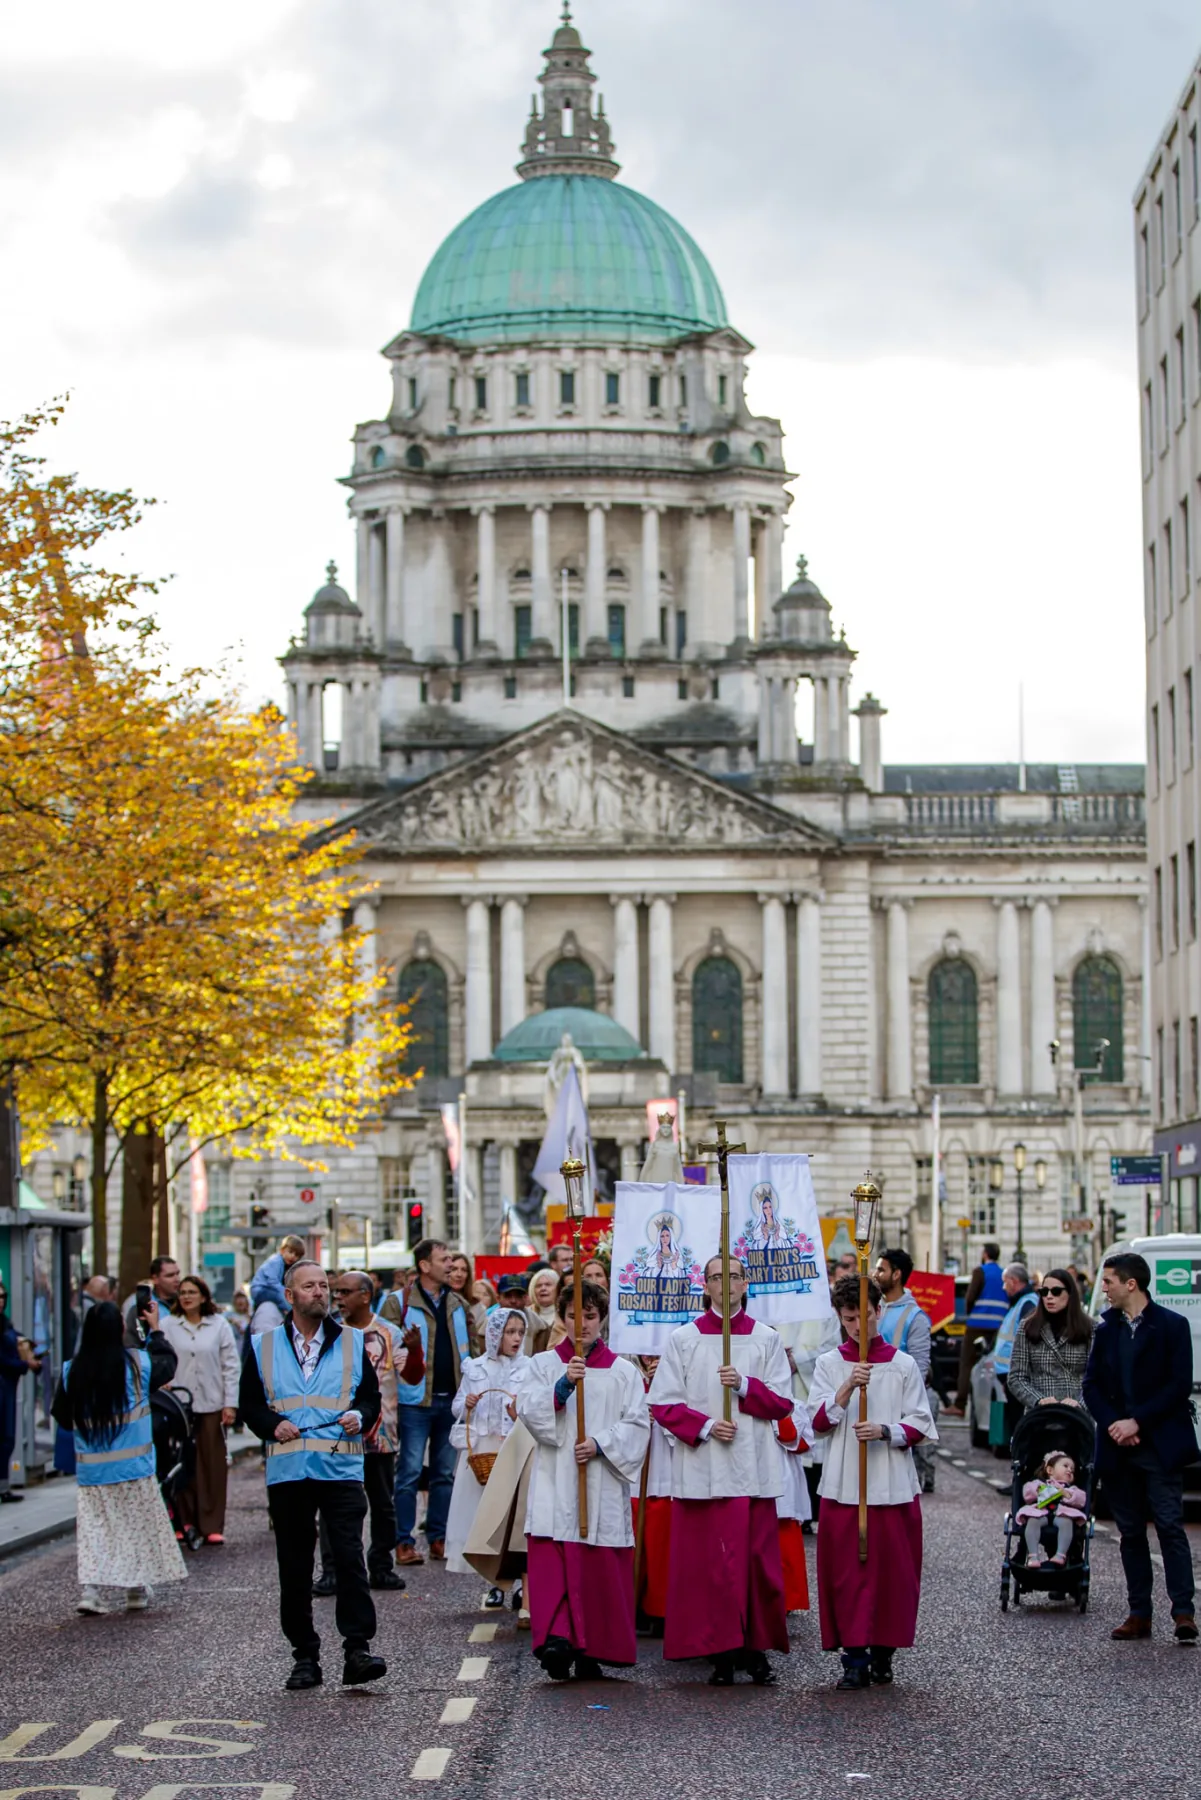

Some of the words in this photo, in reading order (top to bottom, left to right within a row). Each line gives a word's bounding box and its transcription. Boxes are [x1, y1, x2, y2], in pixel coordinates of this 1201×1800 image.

[748, 1250, 765, 1266] OUR
[768, 1248, 800, 1266] LADY'S
[773, 1262, 819, 1282] FESTIVAL
[637, 1278, 657, 1294] OUR
[659, 1278, 690, 1295] LADY'S
[620, 1293, 659, 1311] ROSARY
[661, 1295, 705, 1312] FESTIVAL
